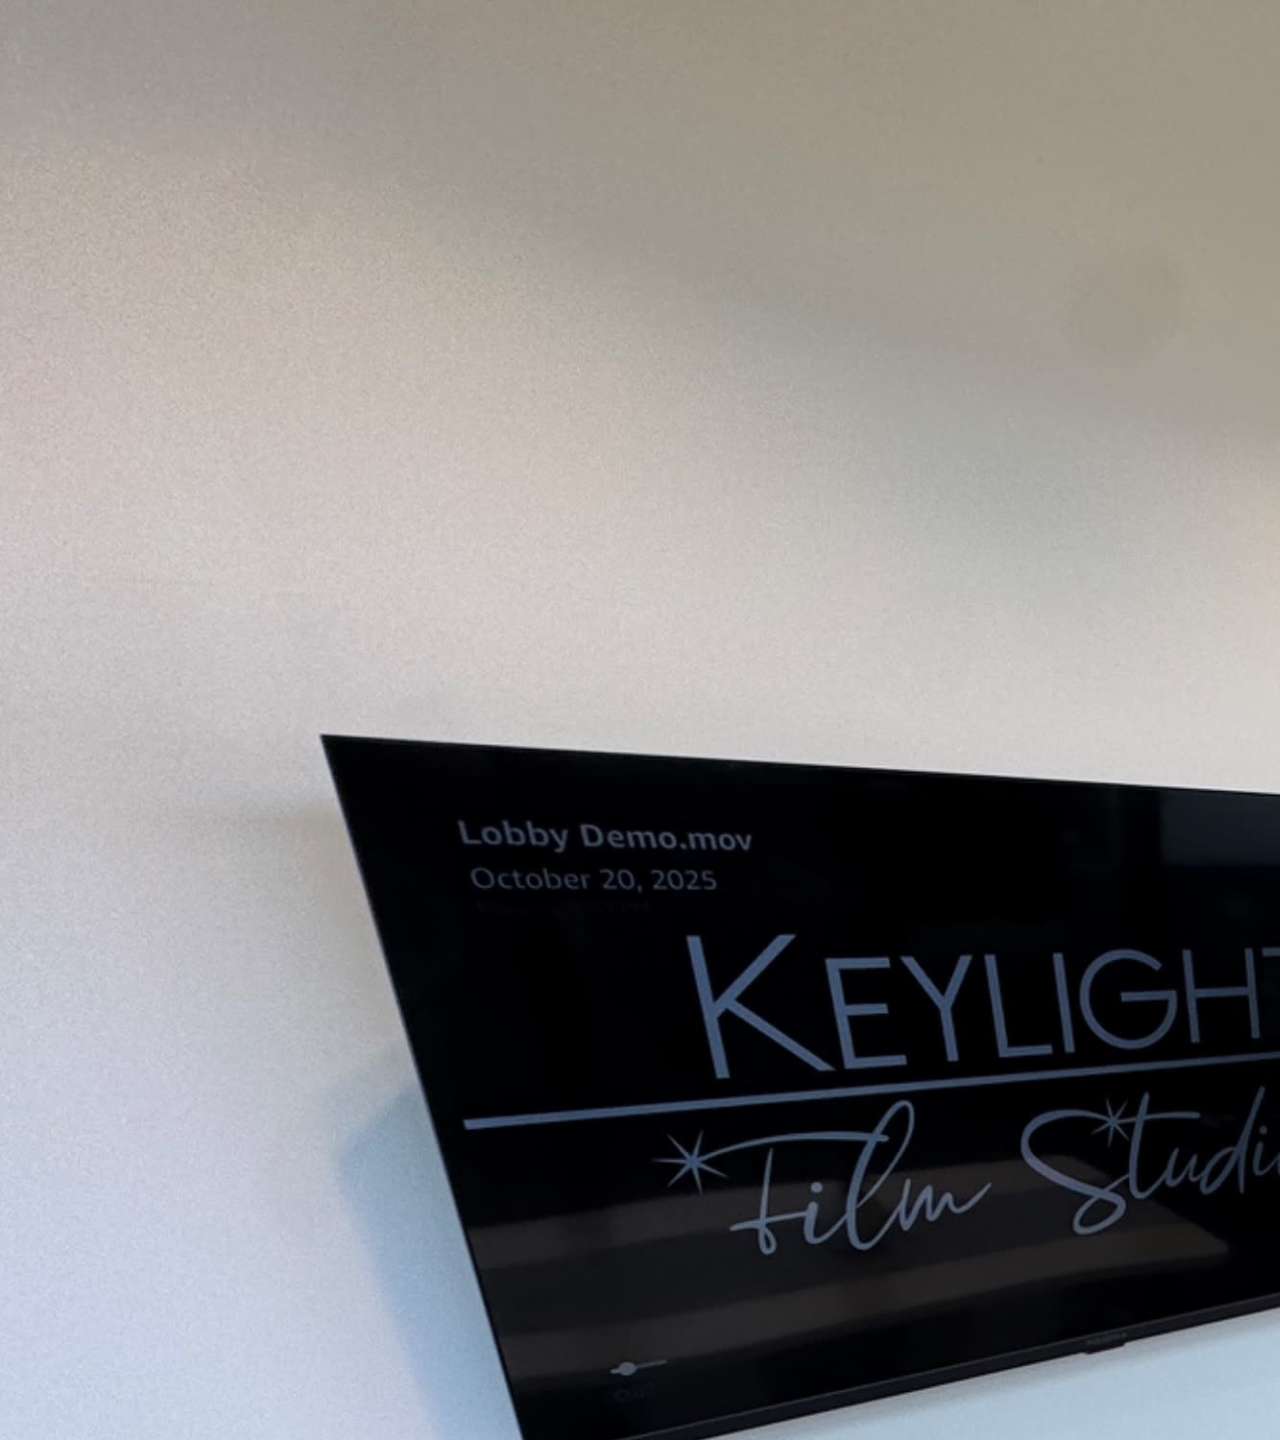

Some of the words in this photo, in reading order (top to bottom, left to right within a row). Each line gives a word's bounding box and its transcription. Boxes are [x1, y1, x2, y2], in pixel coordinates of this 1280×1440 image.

[457, 819, 569, 853] Lobby
[579, 823, 752, 850] Demo.mov
[470, 867, 591, 890] October
[600, 868, 644, 893] 20,
[652, 869, 718, 891] 2025
[692, 1100, 992, 1255] Film
